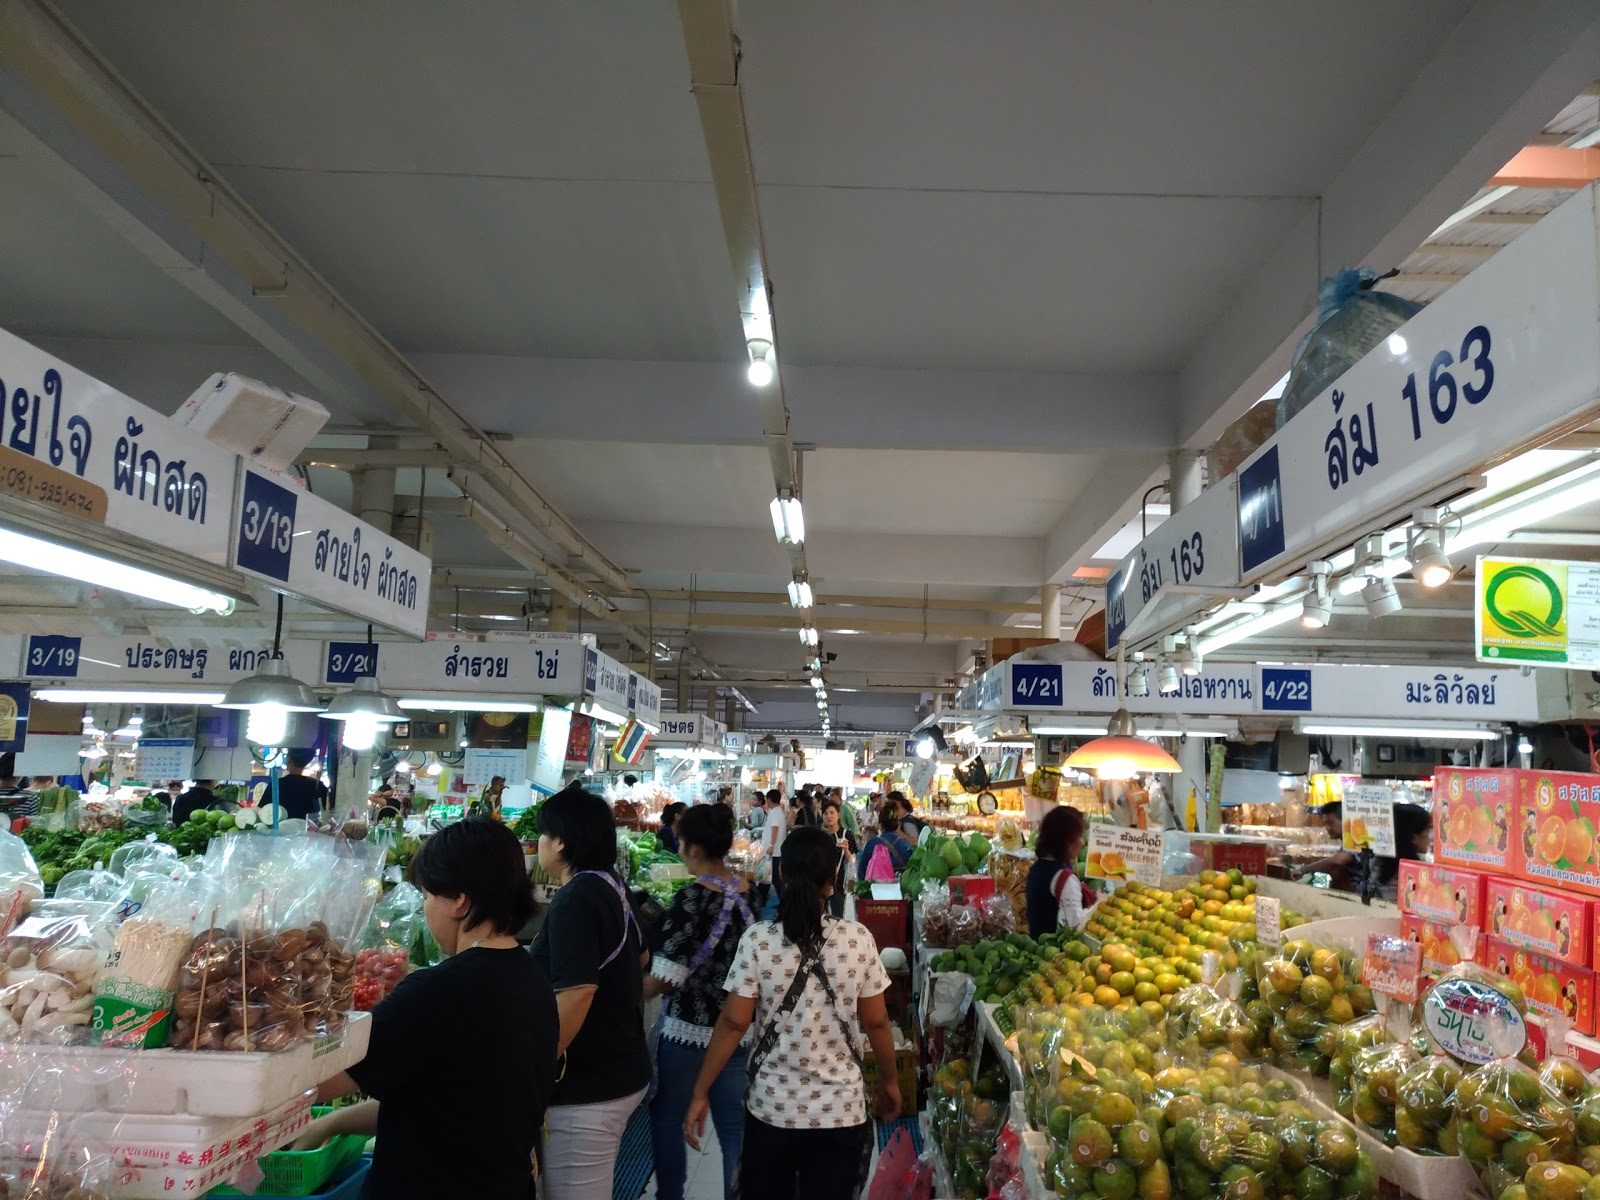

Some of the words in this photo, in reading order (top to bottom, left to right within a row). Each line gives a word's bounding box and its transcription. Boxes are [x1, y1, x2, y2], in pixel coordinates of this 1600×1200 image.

[1325, 389, 1379, 491] ส้ม
[1402, 325, 1495, 441] 163
[114, 416, 208, 525] ผักสด
[244, 501, 292, 554] 3/13
[315, 527, 371, 591] สายใจ
[378, 547, 417, 611] ผักสด
[1170, 531, 1204, 585] 163
[31, 647, 75, 667] 3/19
[331, 653, 374, 673] 3/20
[445, 645, 508, 678] สำรวย
[535, 649, 559, 679] ไข่
[1016, 677, 1060, 697] 4/21
[1264, 680, 1309, 700] 4/22
[1406, 674, 1498, 705] มะลิวัลย์
